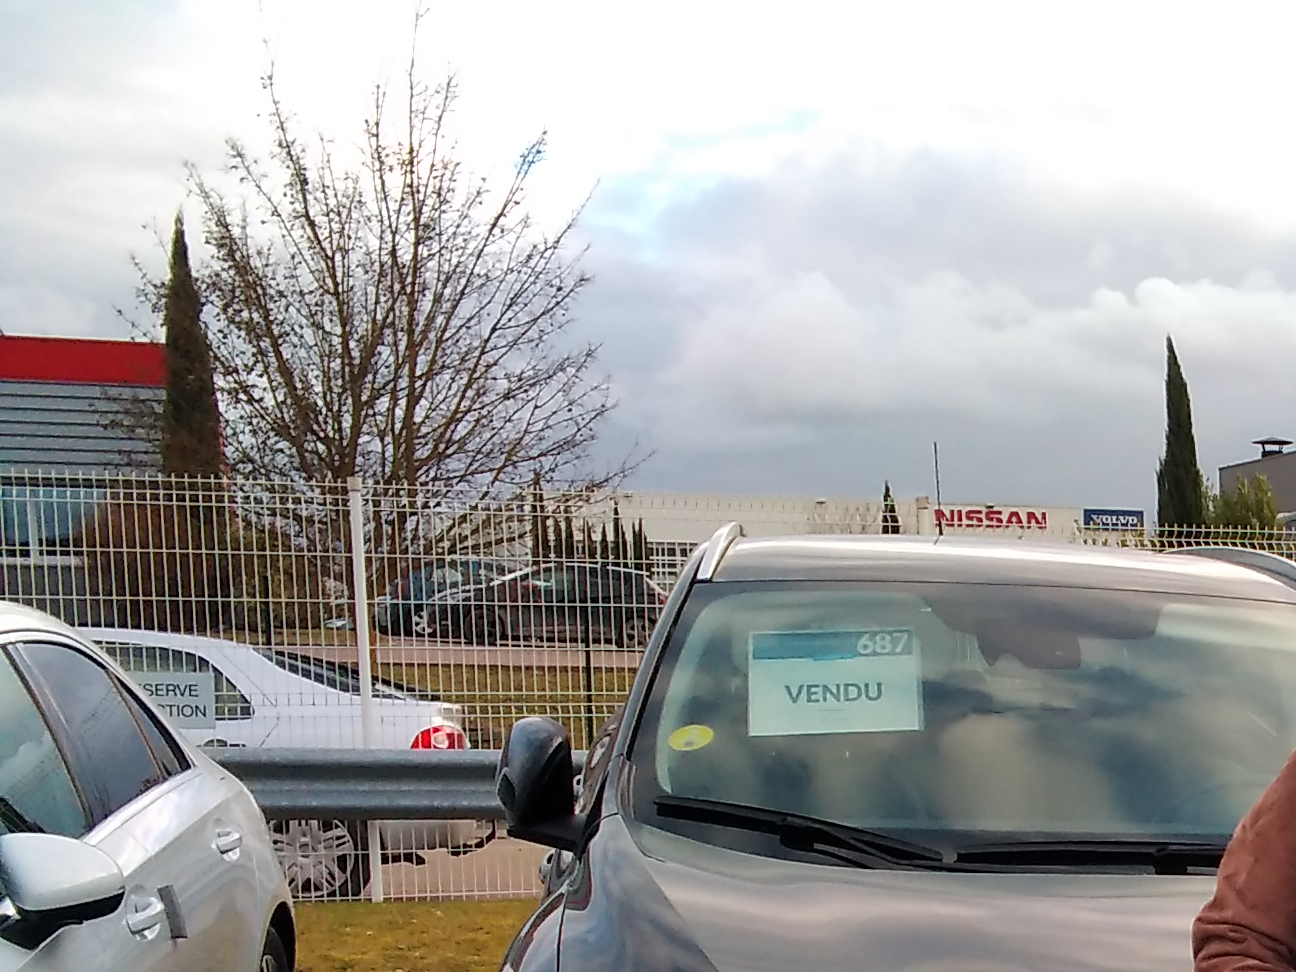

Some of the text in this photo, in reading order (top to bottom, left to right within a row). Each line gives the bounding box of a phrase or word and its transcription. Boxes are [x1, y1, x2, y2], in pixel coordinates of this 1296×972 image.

[934, 509, 1047, 529] NISSAN
[1091, 514, 1138, 526] VOLVO
[856, 633, 908, 654] 687
[138, 683, 199, 698] SERVE
[784, 682, 883, 704] VENDU
[158, 704, 207, 718] TION
